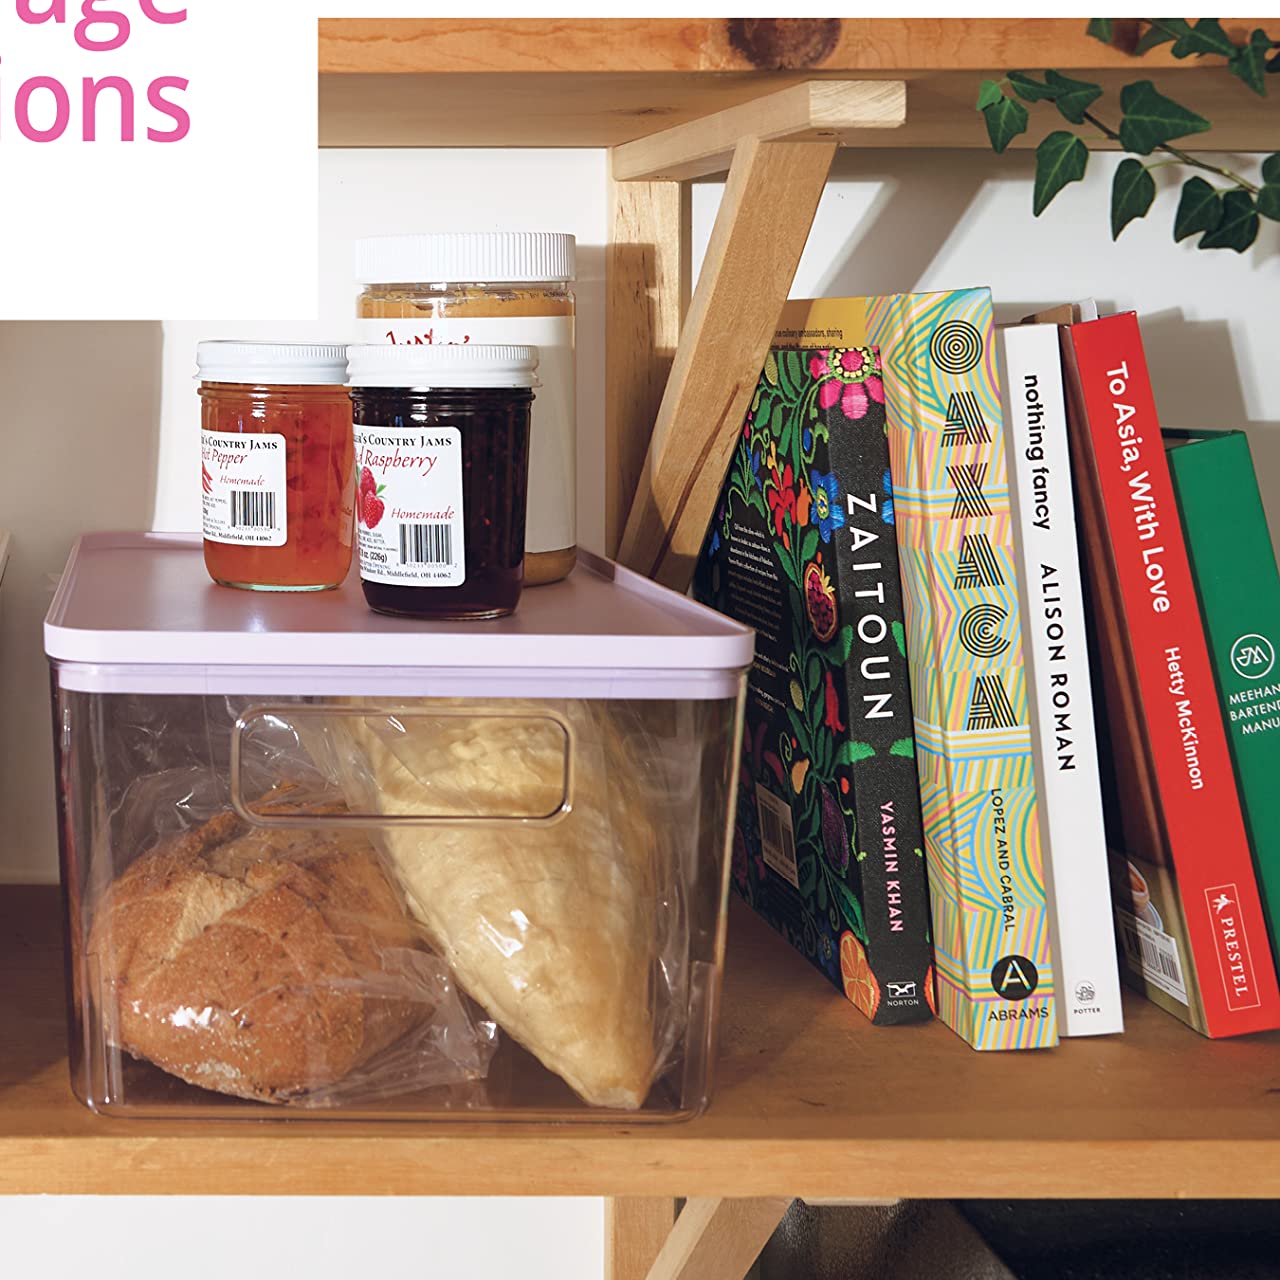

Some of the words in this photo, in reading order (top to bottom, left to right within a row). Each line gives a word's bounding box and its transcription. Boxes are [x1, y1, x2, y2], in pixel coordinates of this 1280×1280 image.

[826, 328, 843, 340] sharing
[1106, 360, 1128, 396] To
[368, 433, 417, 446] COUNTRY
[420, 435, 453, 448] JAMS
[1024, 374, 1047, 461] nothing
[1113, 402, 1144, 472] Asia,
[212, 448, 248, 471] Pepper
[250, 439, 278, 451] JAMS
[365, 448, 438, 477] Raspberry
[219, 474, 265, 486] Homemade
[1032, 466, 1051, 531] fancy
[391, 505, 455, 520] Homemade
[929, 320, 1019, 731] OAXACA
[1128, 471, 1161, 541] With
[1142, 546, 1171, 613] Love
[847, 493, 894, 720] ZAITOUN
[1040, 563, 1067, 662] ALISON
[1164, 646, 1185, 697] Hetty
[1175, 699, 1204, 791] McKinnon
[1229, 683, 1280, 705] MEEHAN
[1049, 673, 1076, 772] ROMAN
[880, 801, 899, 873] YASMIN
[991, 788, 1006, 837] LOPEZ
[997, 840, 1010, 874] AND
[885, 880, 903, 932] KHAN
[999, 876, 1018, 932] CABRAL
[1221, 917, 1250, 998] PRESTEL
[887, 998, 919, 1007] NORTON
[988, 1007, 1049, 1022] ABRAMS
[1073, 1006, 1101, 1015] POTTER
